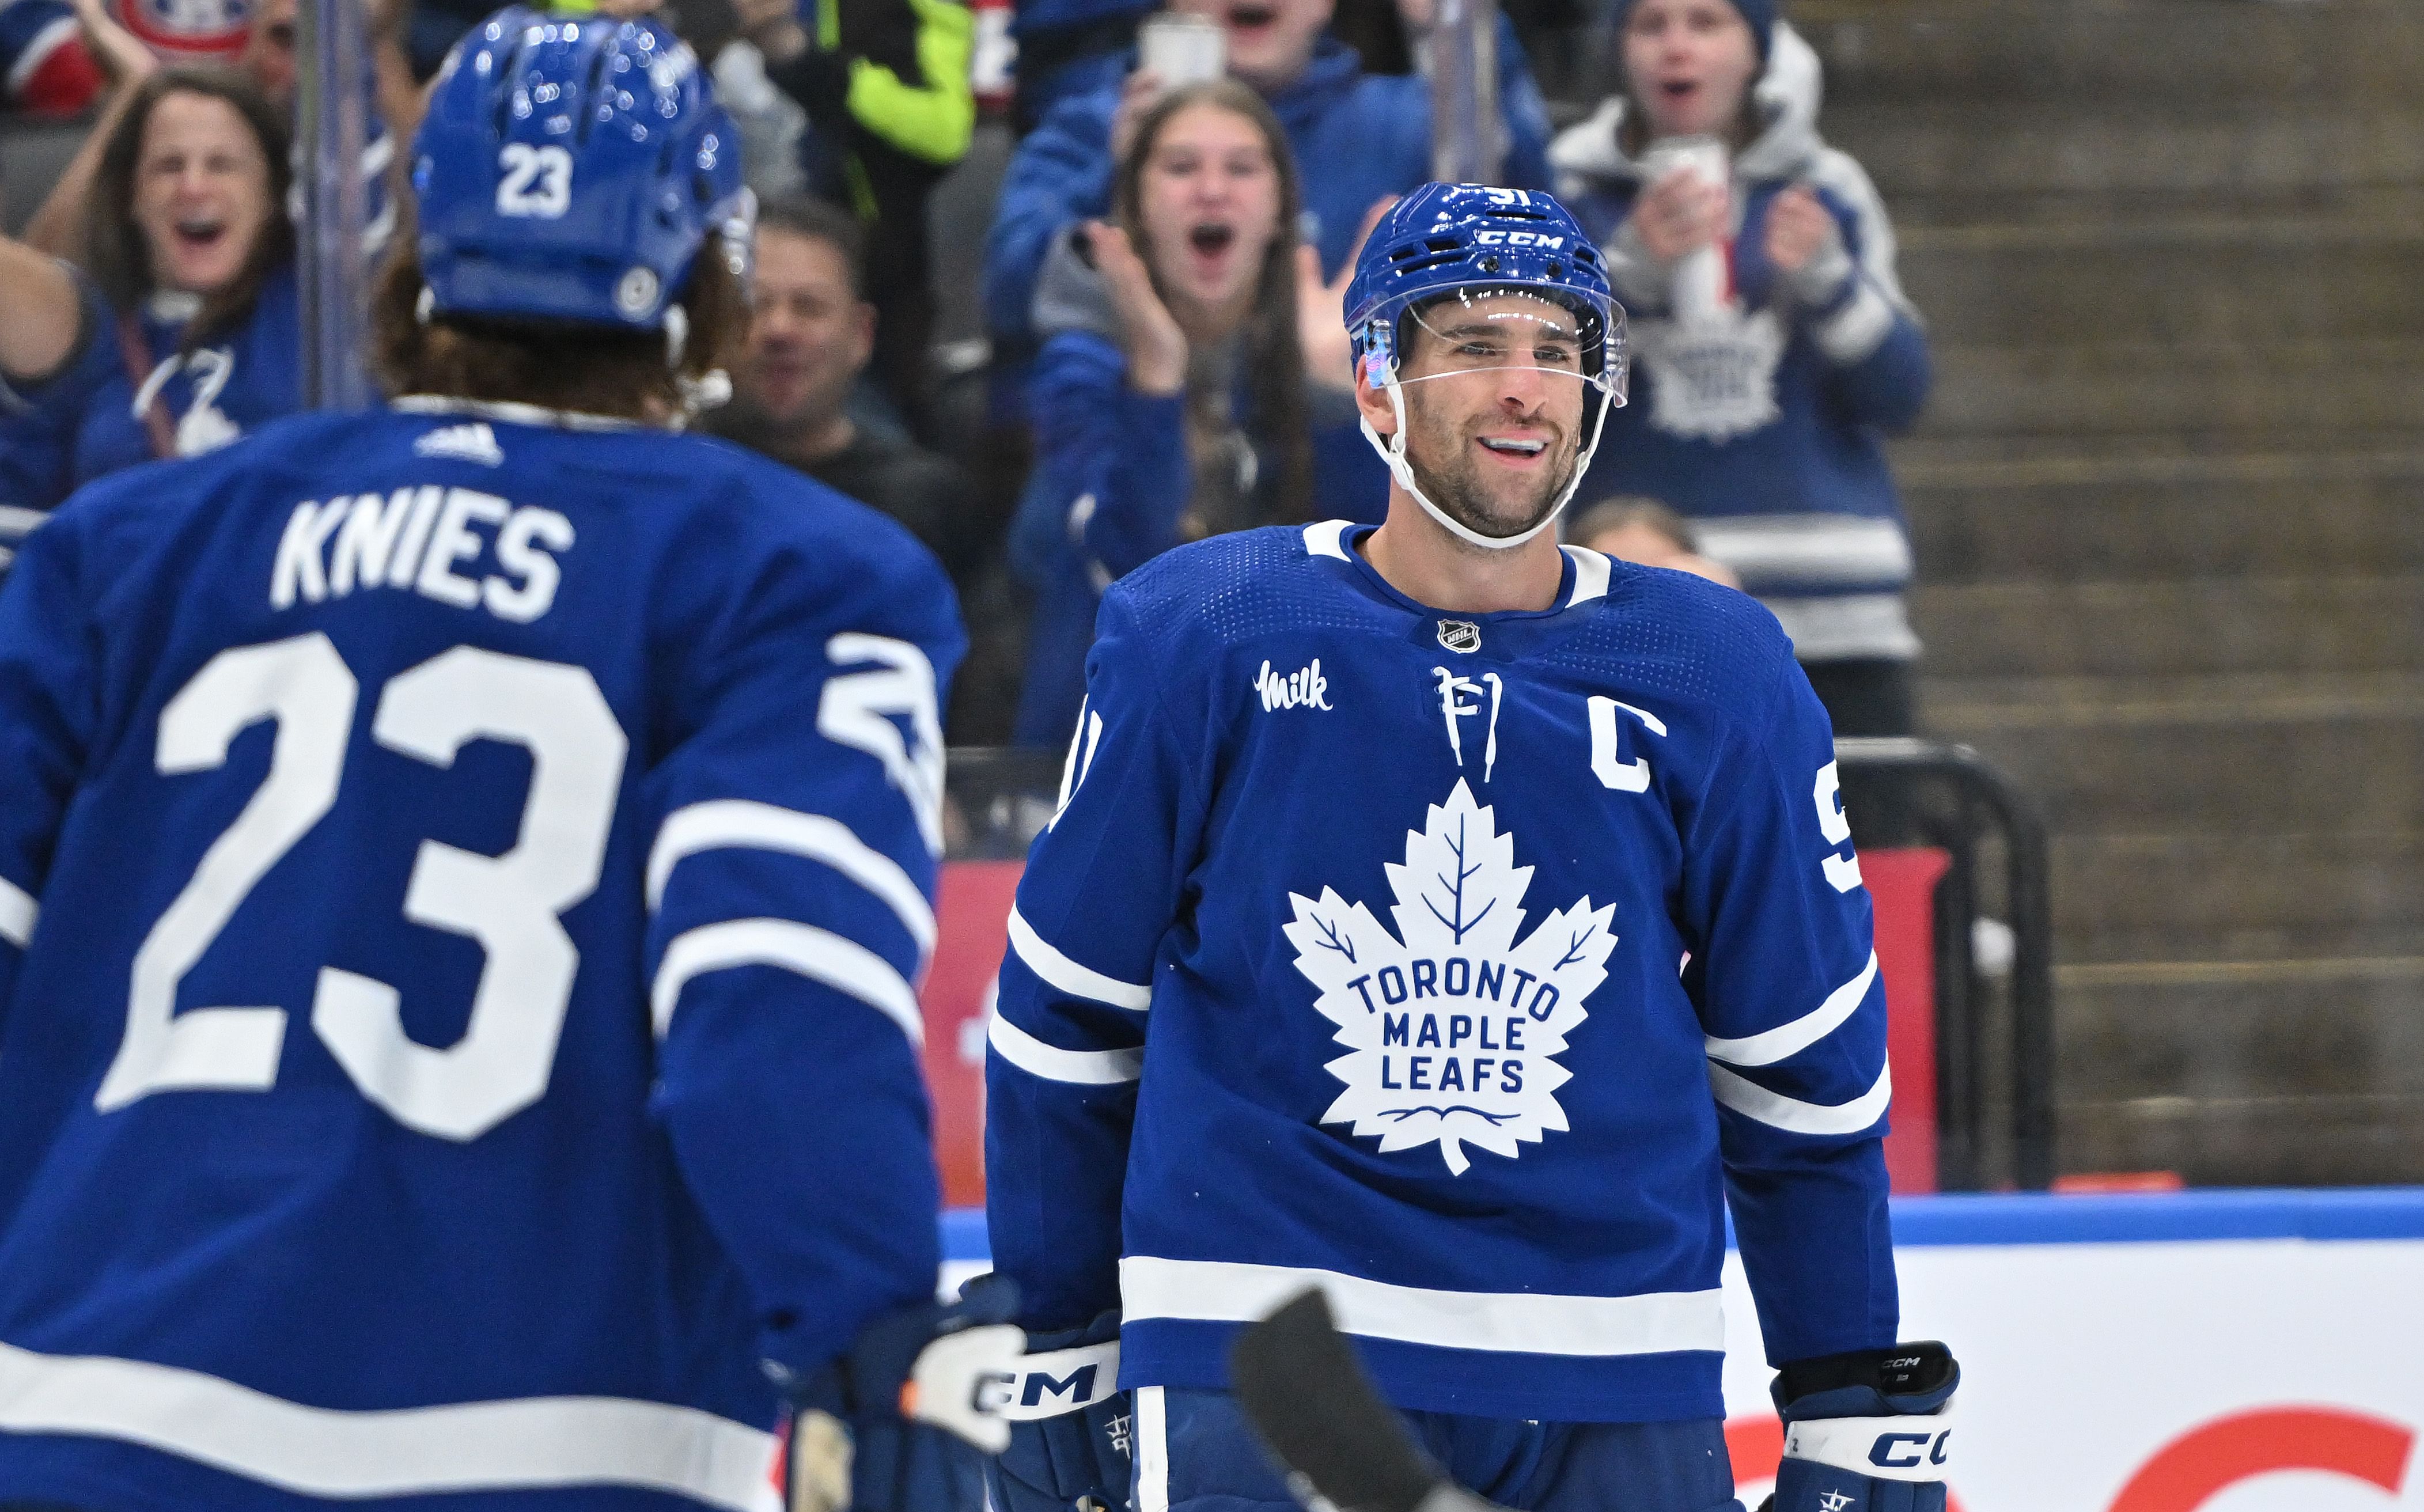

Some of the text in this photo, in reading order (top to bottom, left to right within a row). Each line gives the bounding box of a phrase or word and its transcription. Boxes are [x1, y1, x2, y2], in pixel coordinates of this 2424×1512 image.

[495, 143, 574, 219] 23
[1474, 230, 1565, 250] CCM
[270, 485, 575, 624] KNIES
[1447, 628, 1472, 644] NHL
[1587, 695, 1668, 794] C
[93, 631, 629, 1145] 23
[1346, 957, 1561, 1023] TORONTO
[1383, 1011, 1527, 1051] MAPLE
[1381, 1055, 1524, 1094] LEAFS
[1881, 1356, 1921, 1369] CCM
